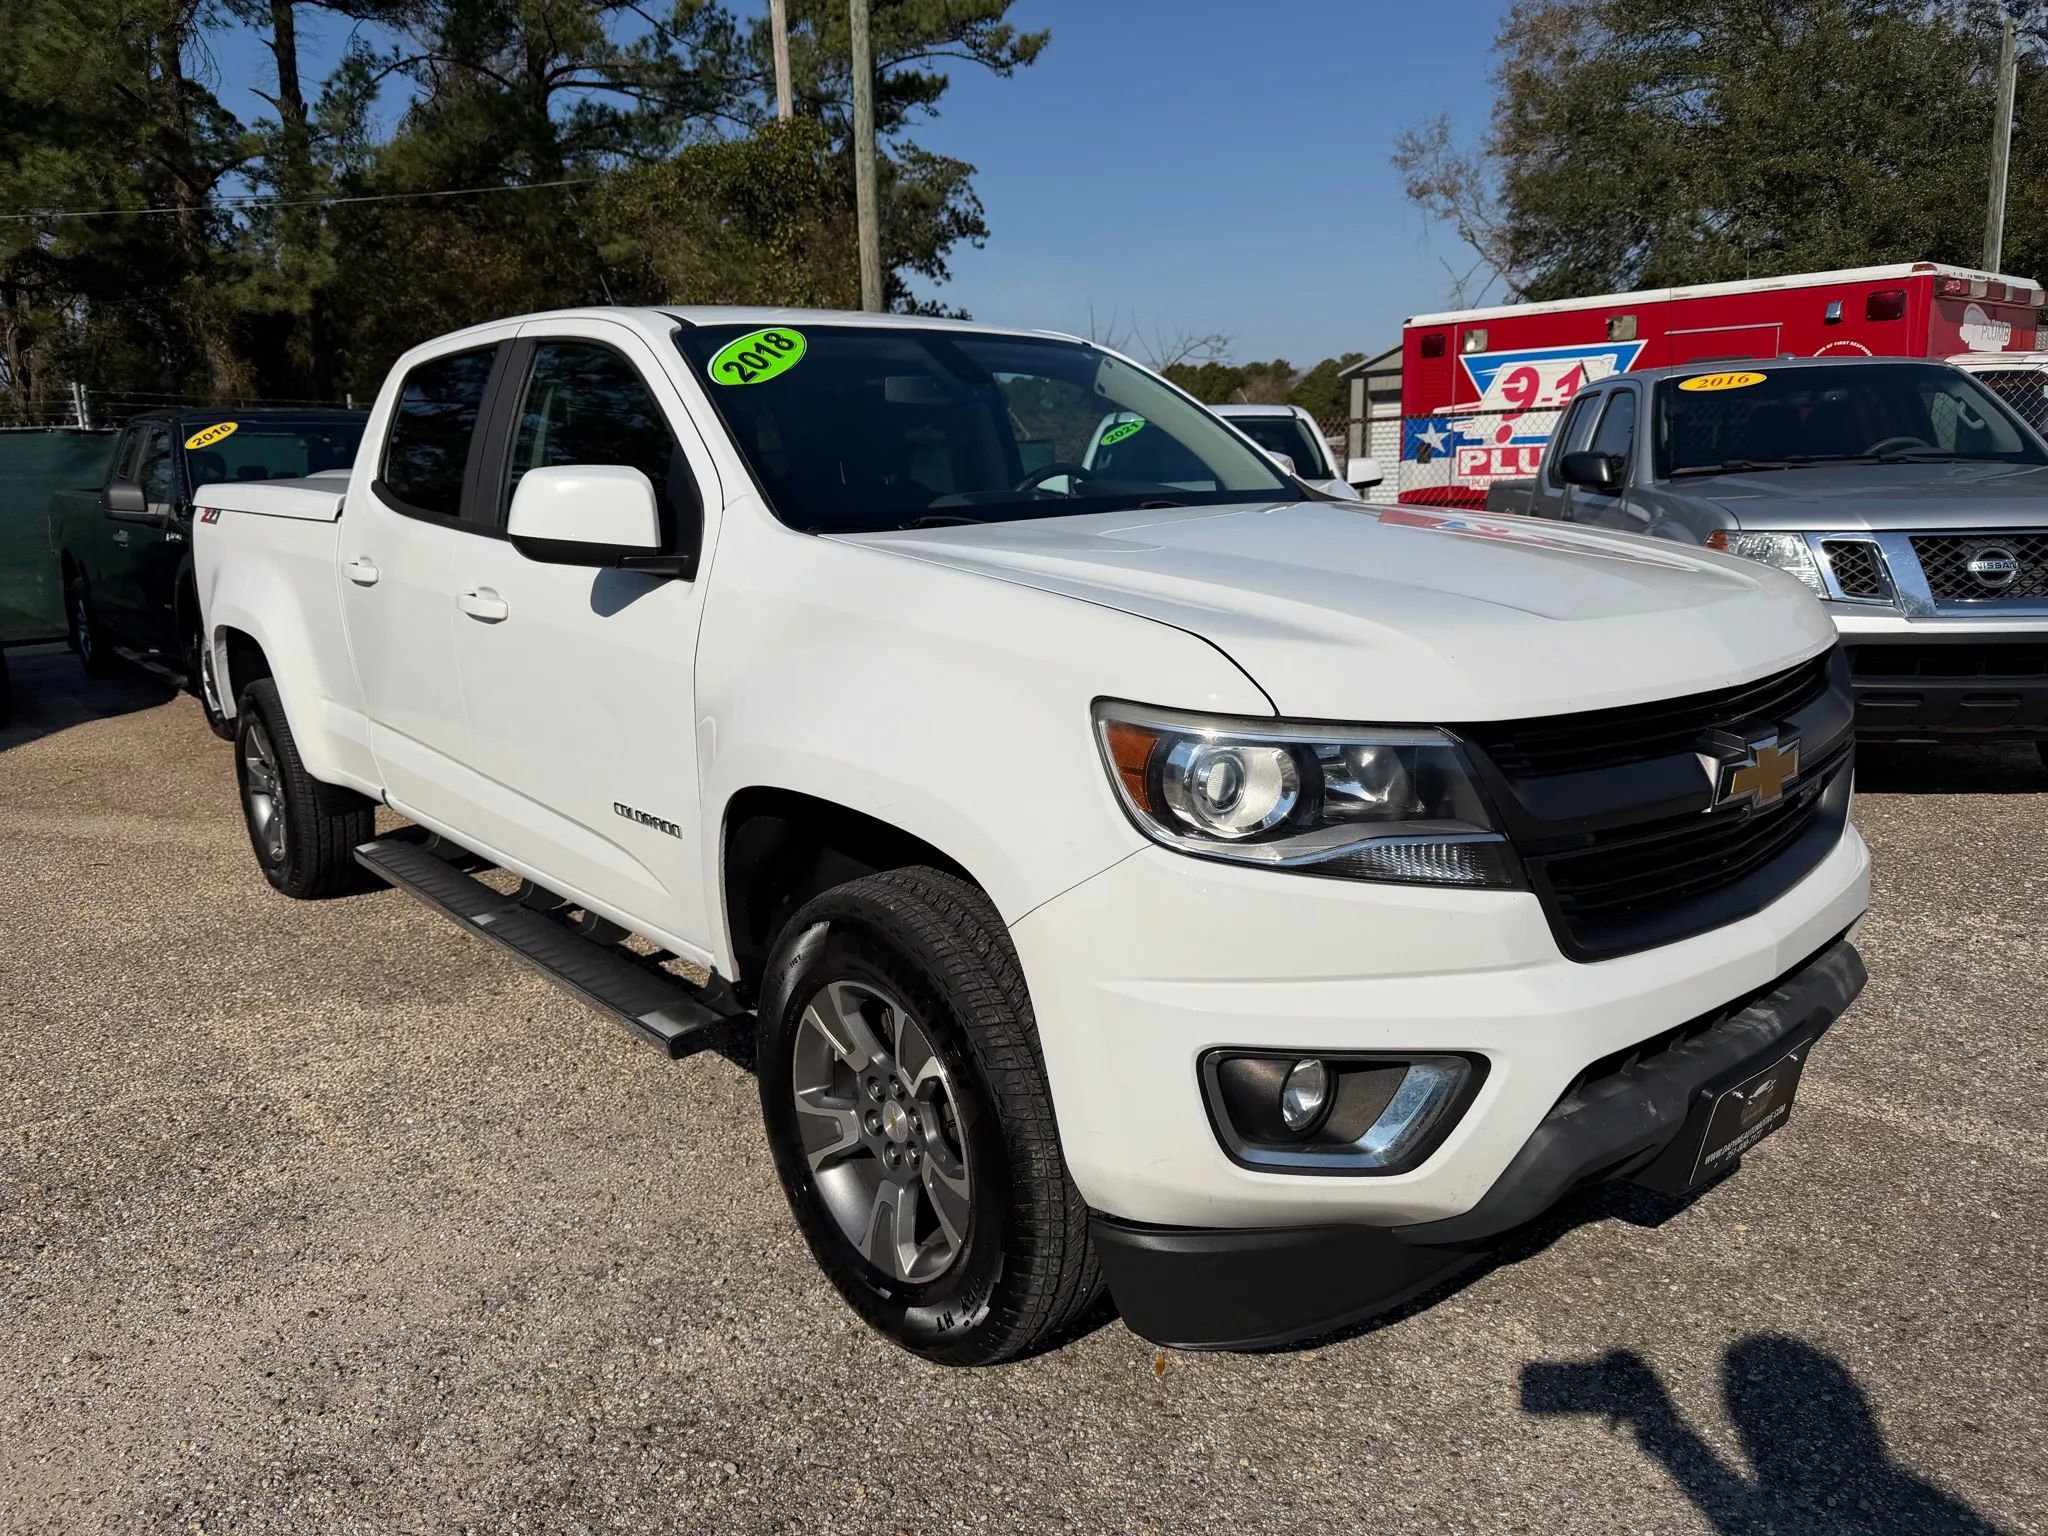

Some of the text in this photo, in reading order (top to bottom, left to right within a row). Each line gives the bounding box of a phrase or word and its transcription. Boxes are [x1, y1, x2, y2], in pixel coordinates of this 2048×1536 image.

[722, 331, 796, 384] 2018
[1695, 373, 1751, 390] 2016
[192, 423, 232, 447] 2016
[1106, 422, 1140, 443] 2021
[1459, 448, 1544, 476] PLU
[1973, 560, 2019, 571] NISSAN
[613, 801, 684, 840] COLORADO
